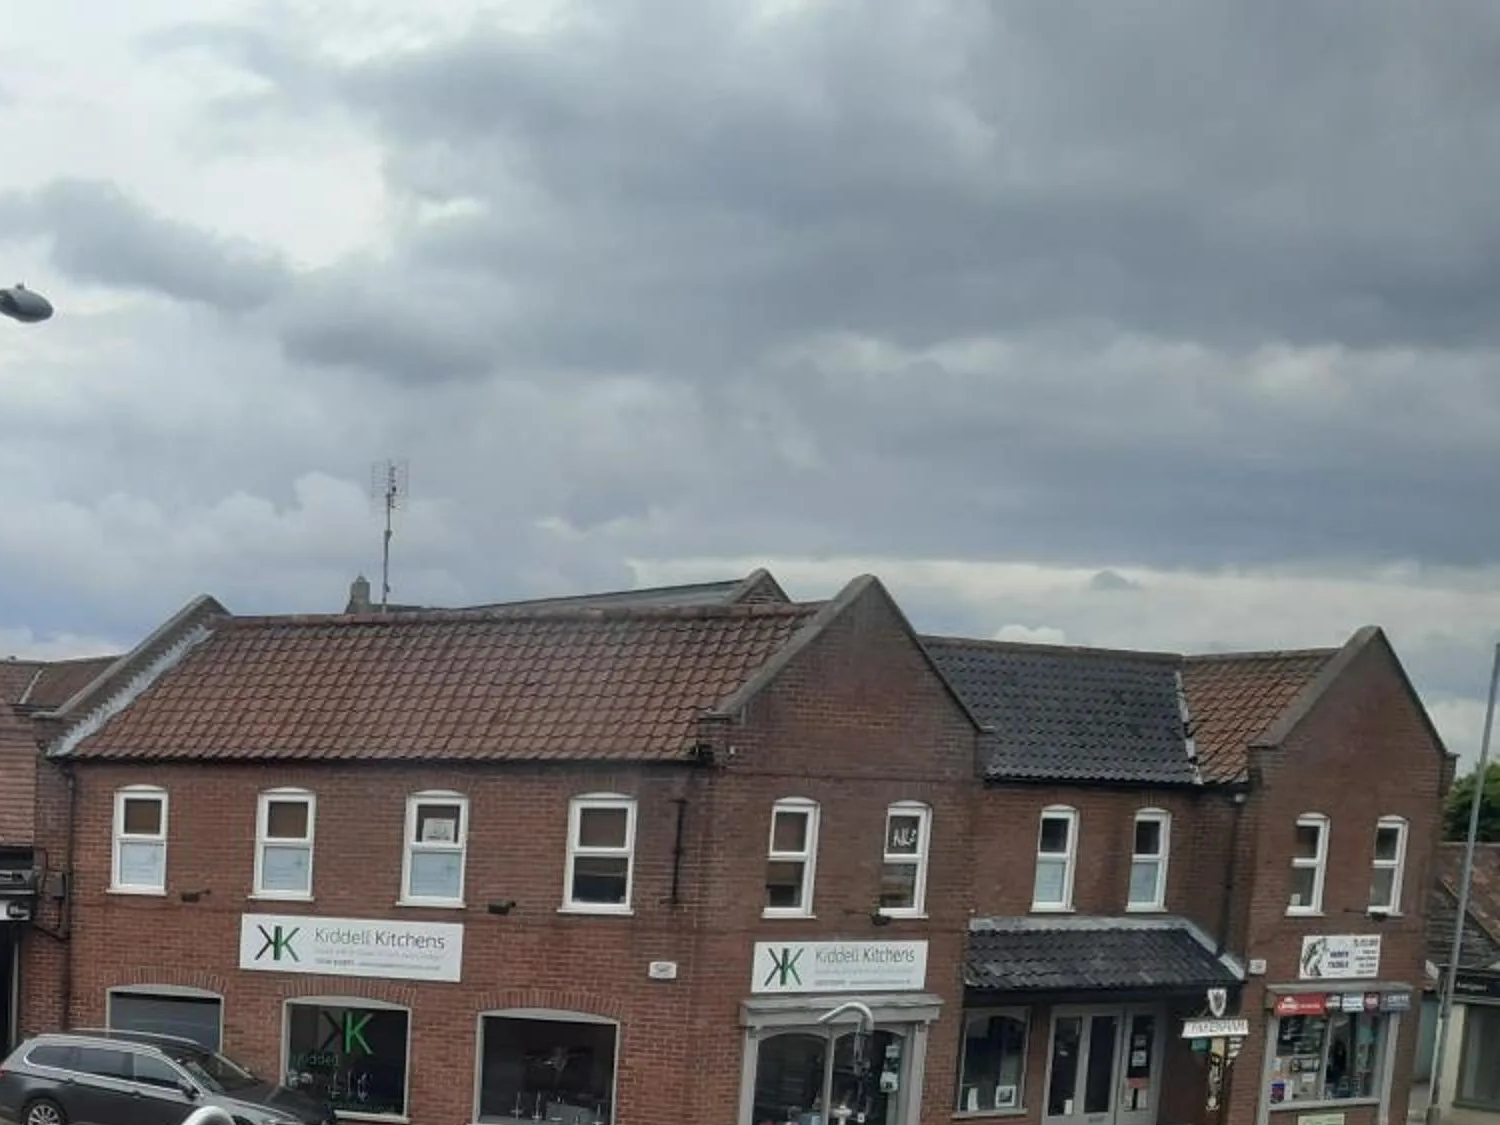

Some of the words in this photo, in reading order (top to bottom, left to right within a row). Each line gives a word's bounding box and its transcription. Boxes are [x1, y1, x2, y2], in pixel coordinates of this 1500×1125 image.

[314, 927, 369, 946] Kiddell
[375, 931, 445, 950] Kitchens
[815, 947, 858, 963] Kiddell
[862, 947, 915, 963] Kitchens
